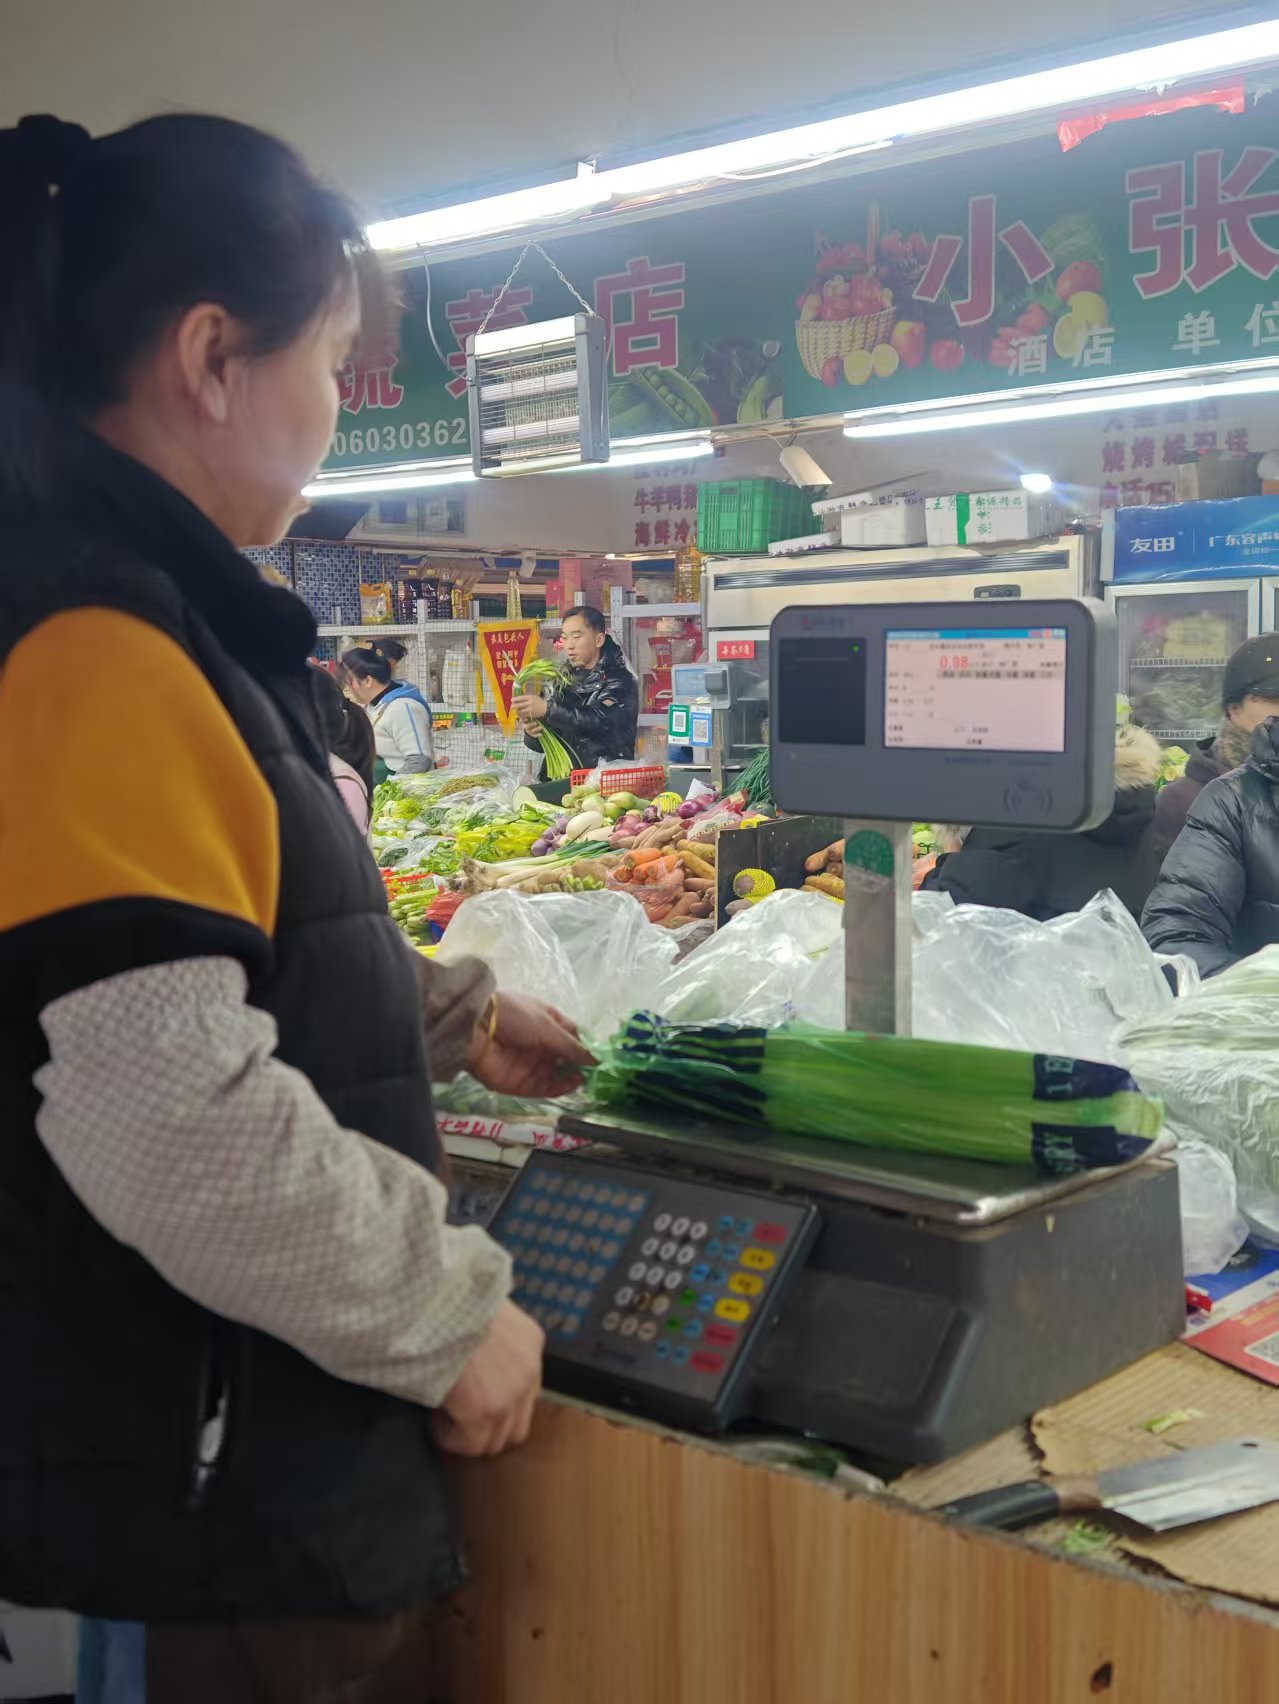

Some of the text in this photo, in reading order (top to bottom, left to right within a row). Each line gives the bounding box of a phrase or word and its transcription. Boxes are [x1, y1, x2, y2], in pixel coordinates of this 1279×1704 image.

[635, 517, 697, 547] 海鲜冷
[1130, 536, 1175, 553] 友田
